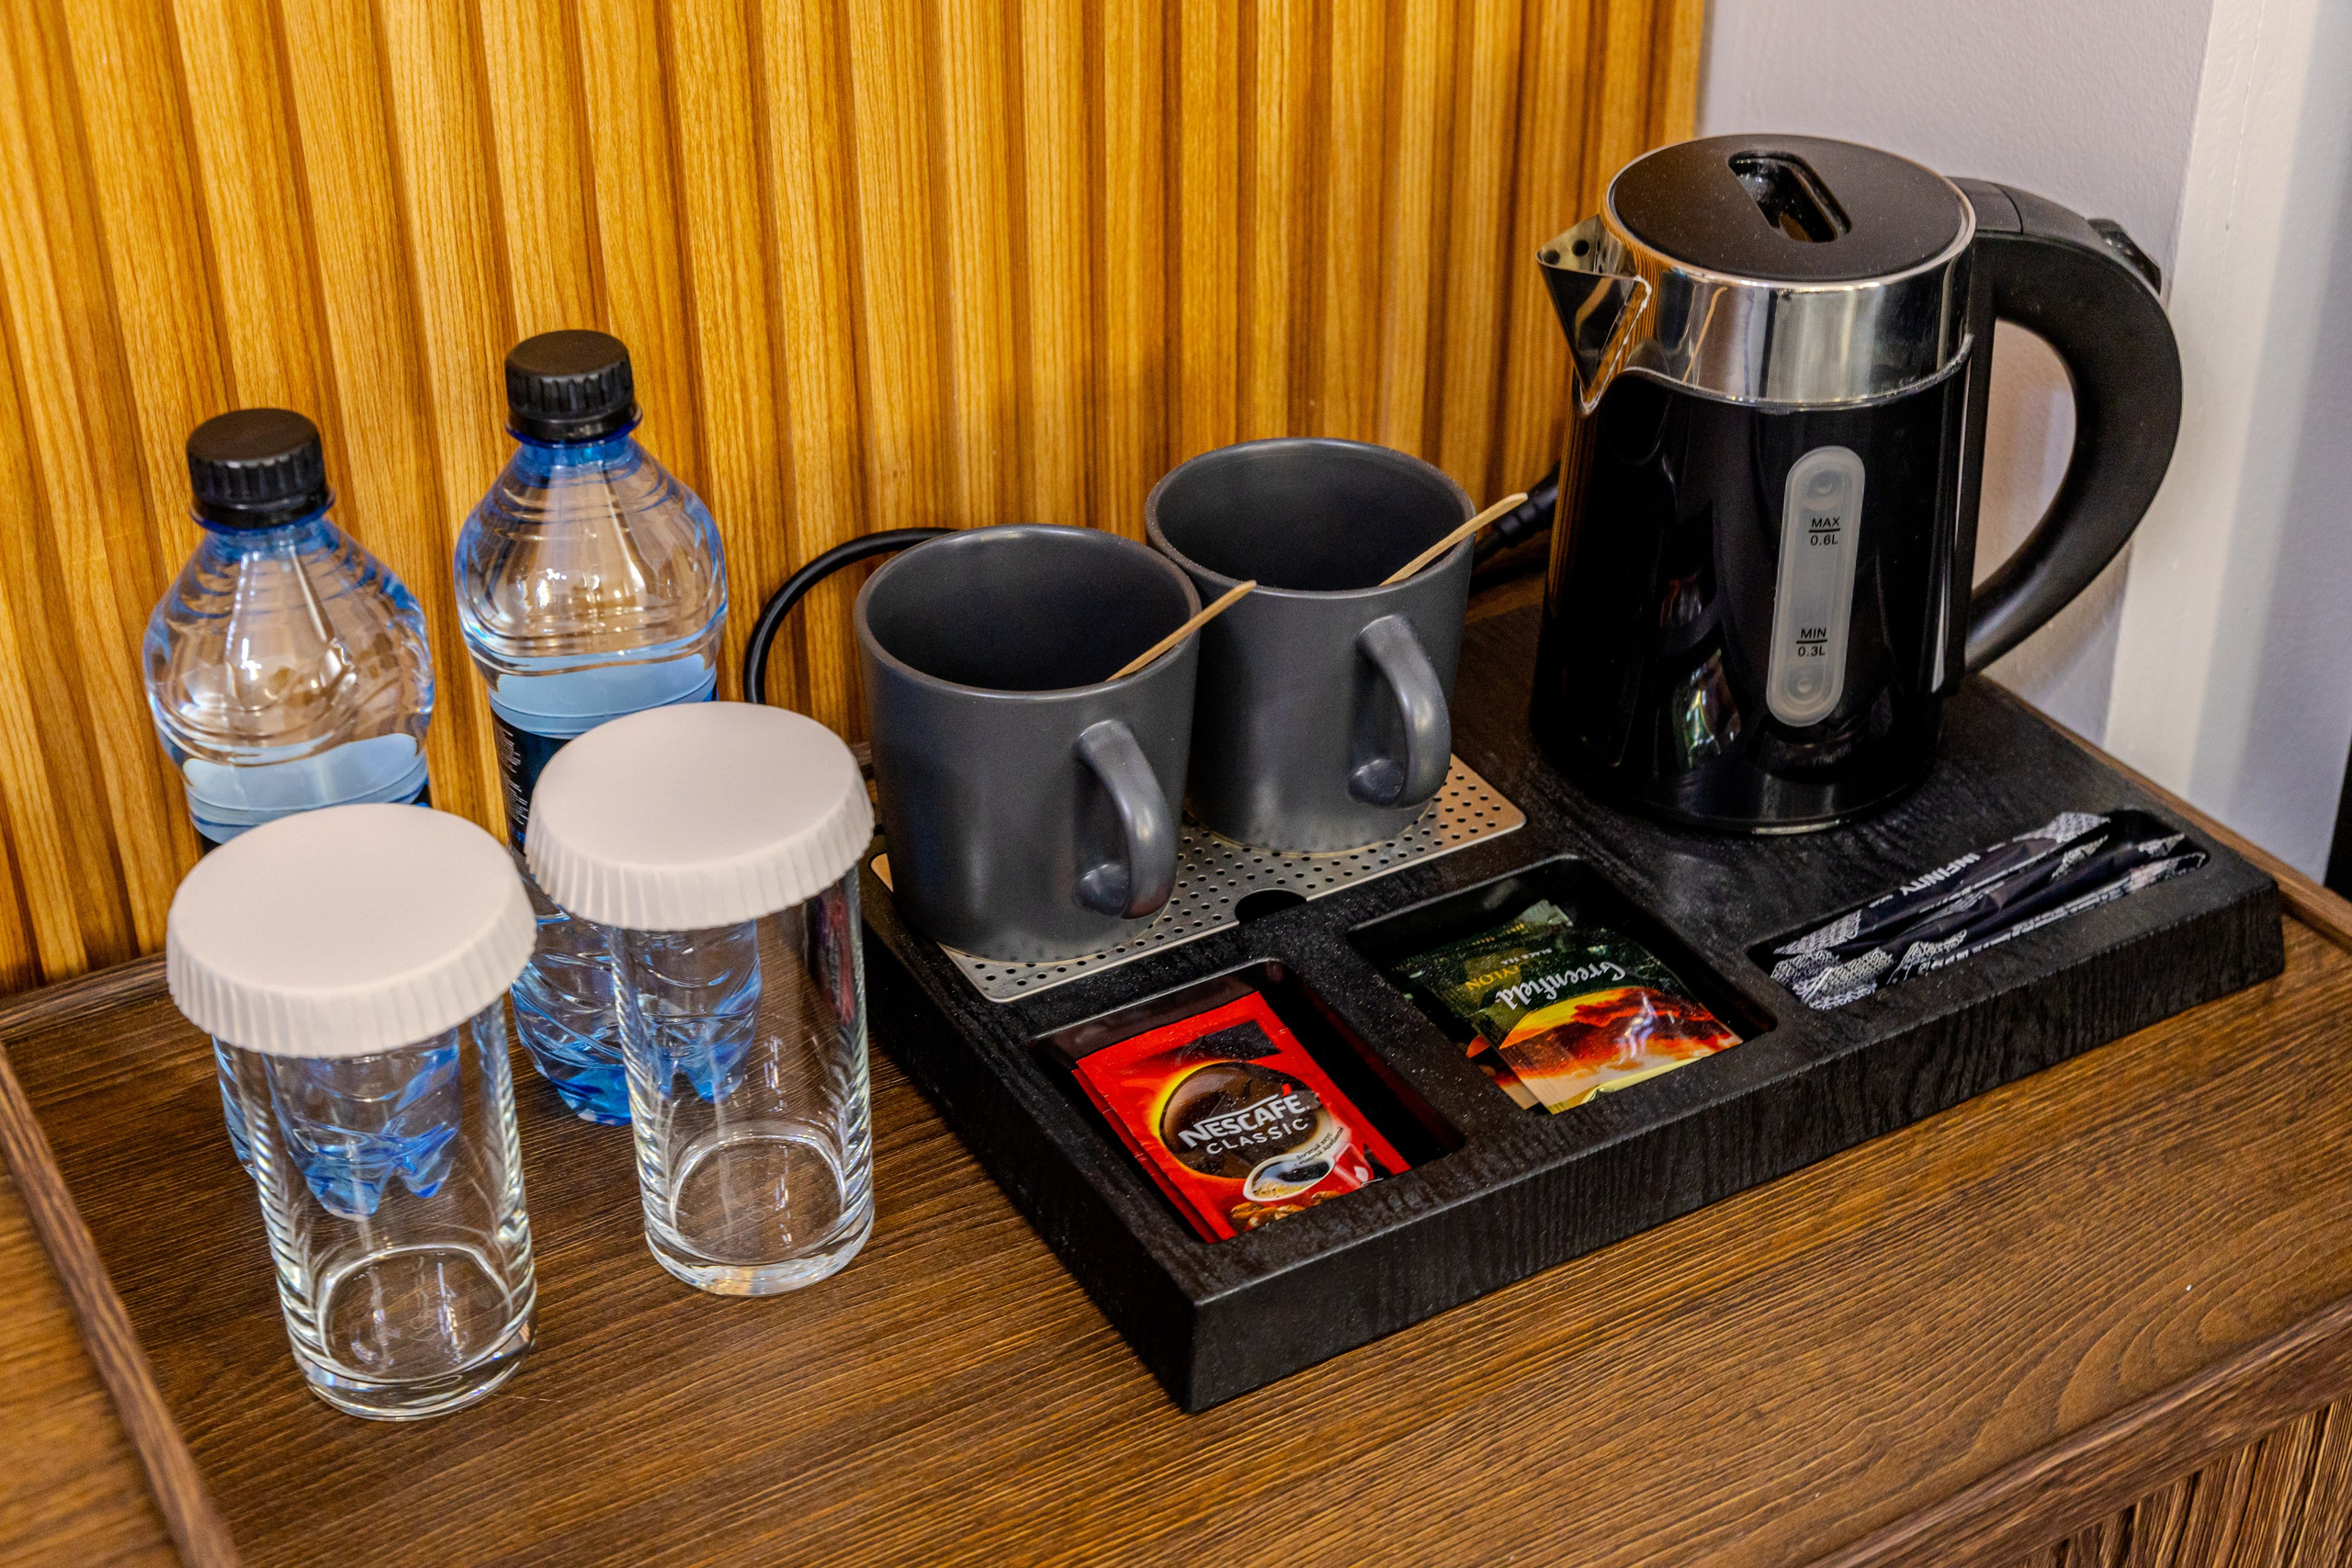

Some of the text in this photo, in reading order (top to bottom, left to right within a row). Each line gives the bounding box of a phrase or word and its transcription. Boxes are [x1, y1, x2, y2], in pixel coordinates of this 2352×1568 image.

[1811, 516, 1840, 528] MAX
[1810, 533, 1839, 547] 0.6L
[1800, 627, 1827, 639] MIN
[1797, 645, 1826, 657] 0.3L
[1899, 852, 1981, 897] INFINITY
[1495, 961, 1626, 1010] Greenfield
[1205, 1118, 1309, 1155] CLASSIC
